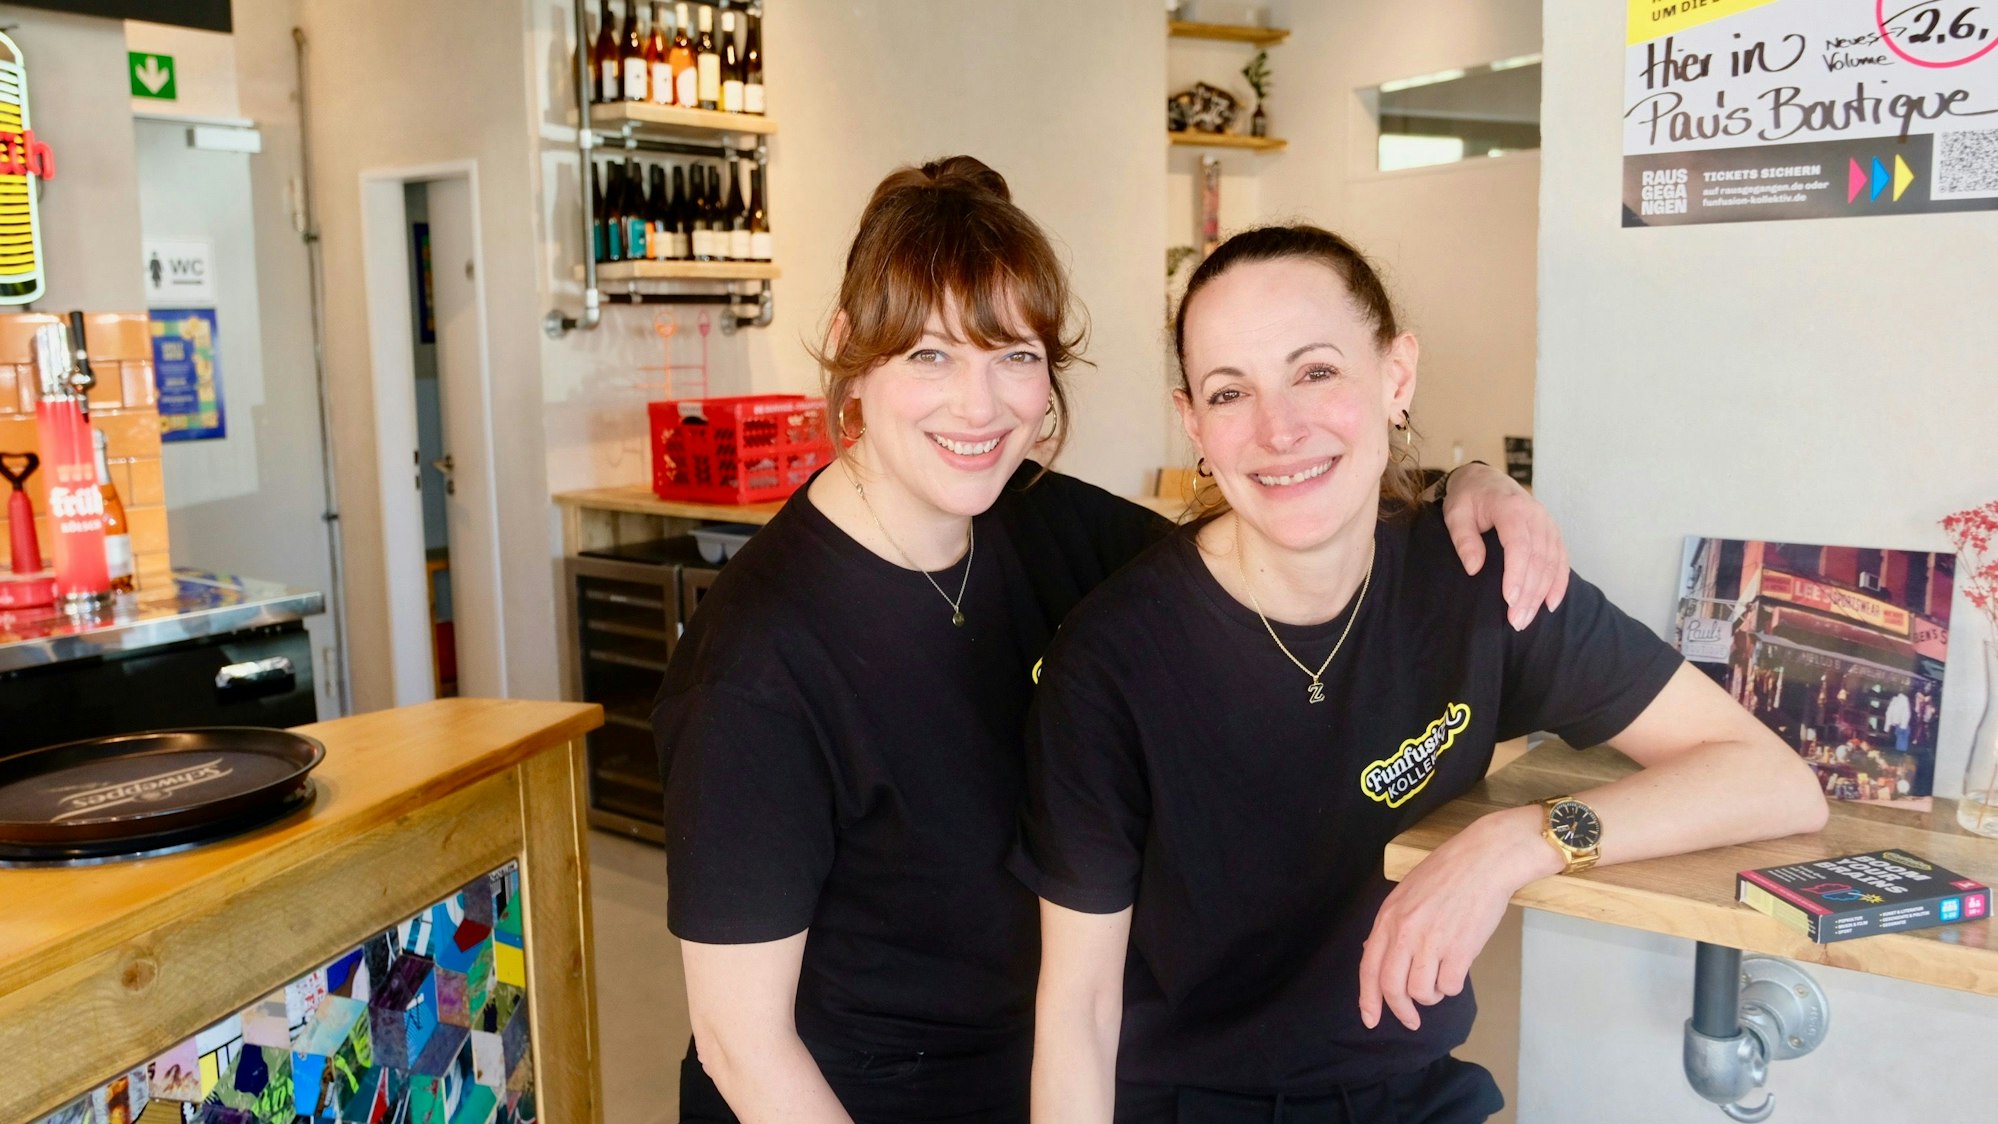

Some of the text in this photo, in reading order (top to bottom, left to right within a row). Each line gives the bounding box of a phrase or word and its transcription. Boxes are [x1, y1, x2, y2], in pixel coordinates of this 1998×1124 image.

[1652, 0, 1708, 21] UM DIE
[1639, 33, 1806, 90] Hier in
[1823, 52, 1895, 72] Volume
[1757, 80, 1998, 145] Boutique
[1642, 168, 1688, 185] RAUS
[1703, 165, 1821, 182] TICKETS SICHERN
[1641, 184, 1688, 201] GEGA
[1702, 186, 1719, 196] auf
[1641, 199, 1688, 215] NGEN
[170, 258, 204, 275] WC
[1308, 683, 1325, 704] Z
[71, 766, 222, 808] Schweppes
[1812, 861, 1909, 894] BRAINS
[1836, 858, 1903, 881] YOUR
[1851, 855, 1932, 881] BOOM
